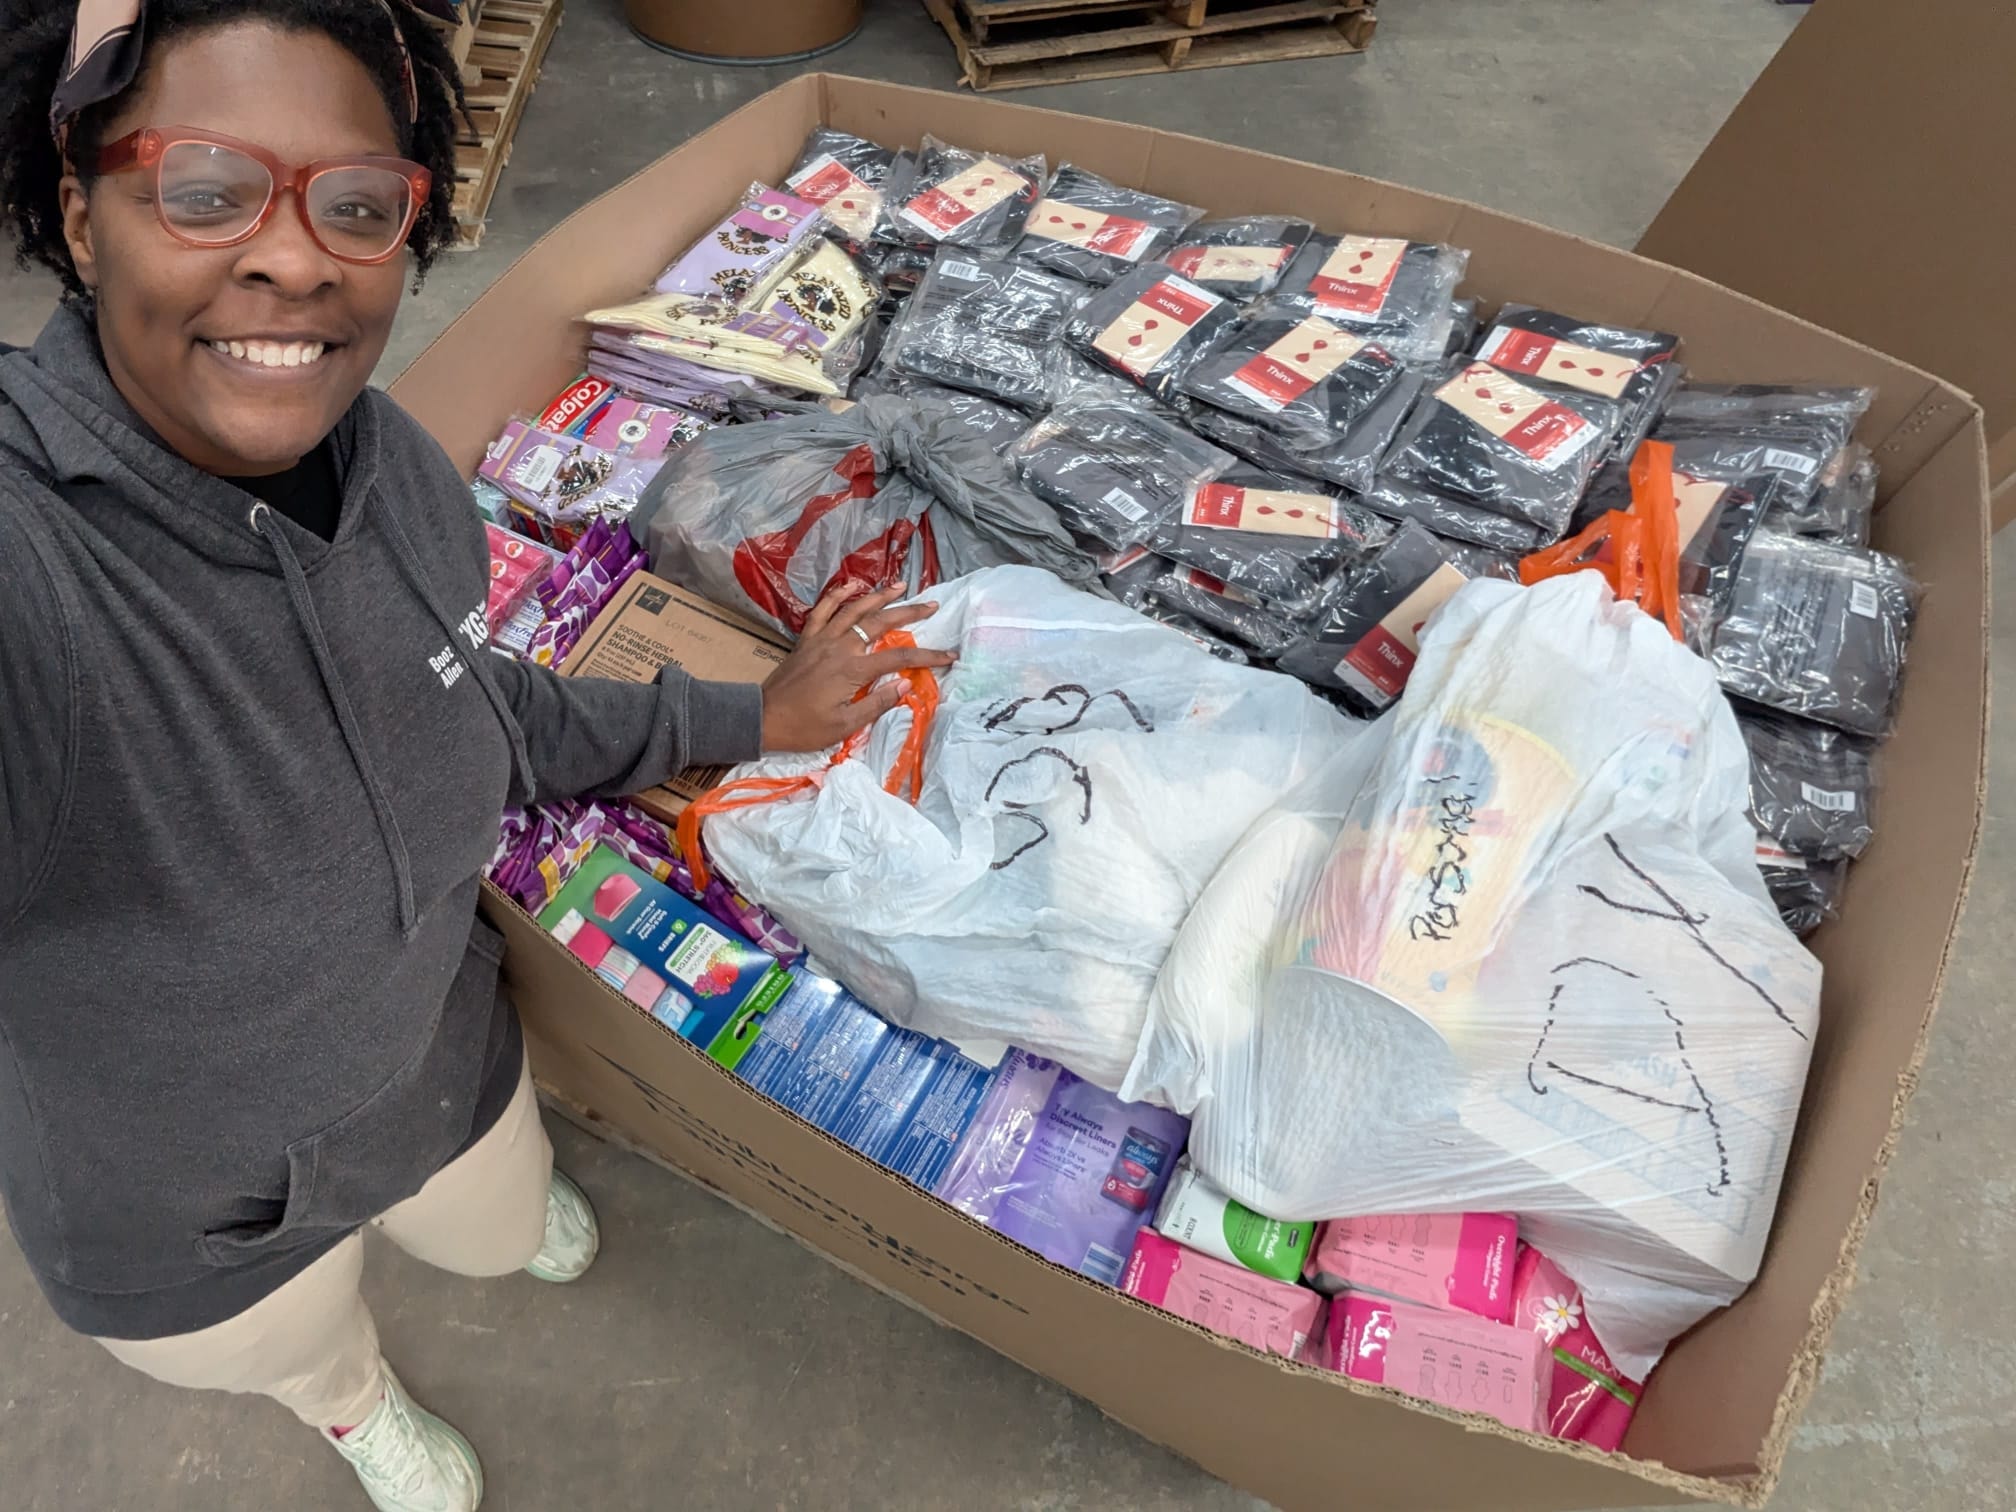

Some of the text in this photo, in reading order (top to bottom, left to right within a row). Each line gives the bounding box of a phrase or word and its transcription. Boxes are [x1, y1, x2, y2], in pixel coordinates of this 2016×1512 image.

[717, 231, 770, 256] PRINCESS
[1327, 281, 1360, 296] Thinx
[1157, 297, 1184, 316] Thinx
[1520, 346, 1543, 367] Thinx
[1265, 364, 1295, 386] Thinx
[1521, 414, 1553, 438] Thinx
[1219, 495, 1236, 517] Thinx
[612, 631, 652, 654] NO-RINSE
[618, 624, 646, 641] SOOTHE
[428, 646, 454, 673] Booz
[606, 638, 648, 663] SHAMPOO
[1376, 642, 1404, 668] Thinx
[440, 661, 464, 689] Allen
[676, 944, 700, 974] STRETCH
[1050, 1112, 1117, 1149] Discreet Liners
[1071, 1111, 1104, 1131] Always
